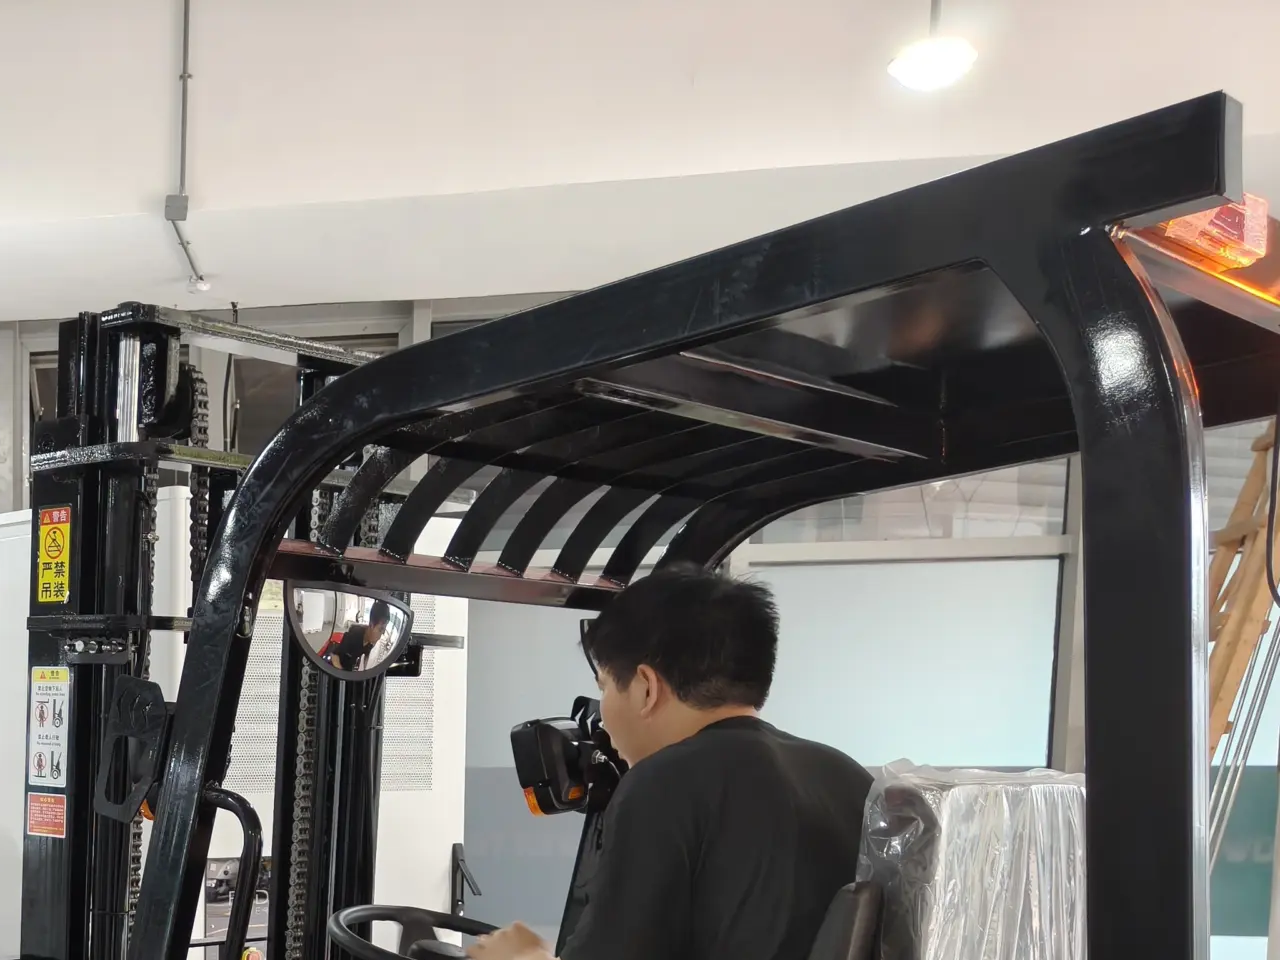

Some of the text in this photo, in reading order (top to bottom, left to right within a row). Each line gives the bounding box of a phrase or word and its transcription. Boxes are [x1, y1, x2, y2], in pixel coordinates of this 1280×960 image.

[52, 510, 68, 523] 警告
[41, 561, 66, 579] 严禁
[40, 581, 65, 599] 吊装
